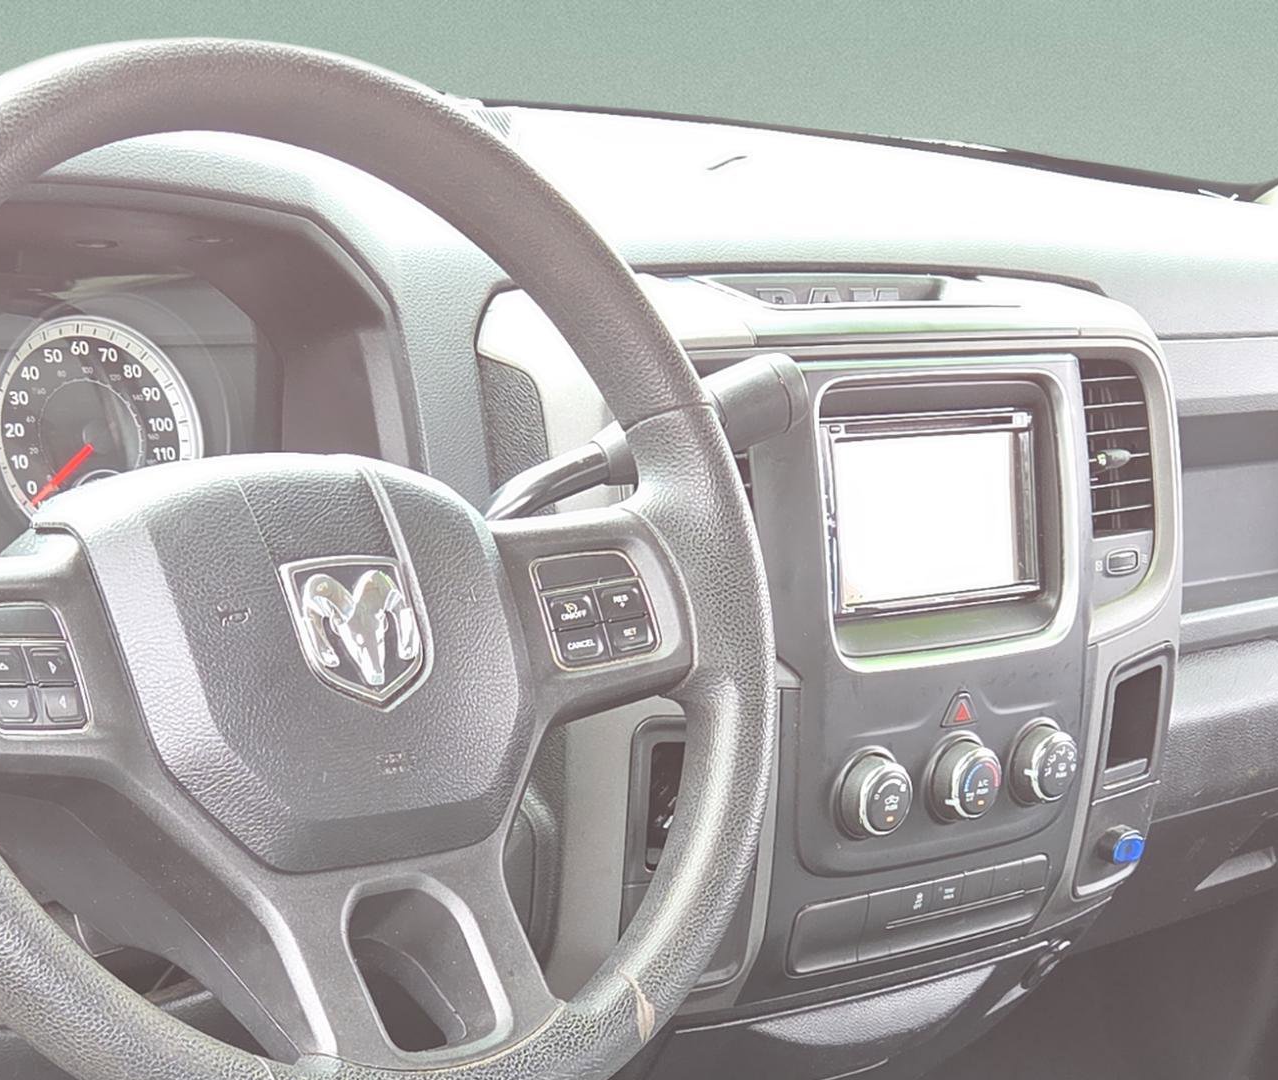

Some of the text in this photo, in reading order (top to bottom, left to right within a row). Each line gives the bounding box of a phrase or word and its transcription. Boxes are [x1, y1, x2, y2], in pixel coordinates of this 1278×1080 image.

[71, 341, 89, 355] 60
[98, 348, 118, 362] 70
[44, 349, 62, 363] 50
[21, 366, 39, 380] 40
[123, 364, 142, 378] 80
[9, 391, 28, 405] 30
[142, 387, 161, 401] 90
[5, 423, 24, 437] 20
[148, 418, 173, 431] 100
[152, 447, 176, 461] 110
[11, 455, 28, 469] 10
[26, 481, 37, 494] 0
[567, 639, 596, 651] CANCEL
